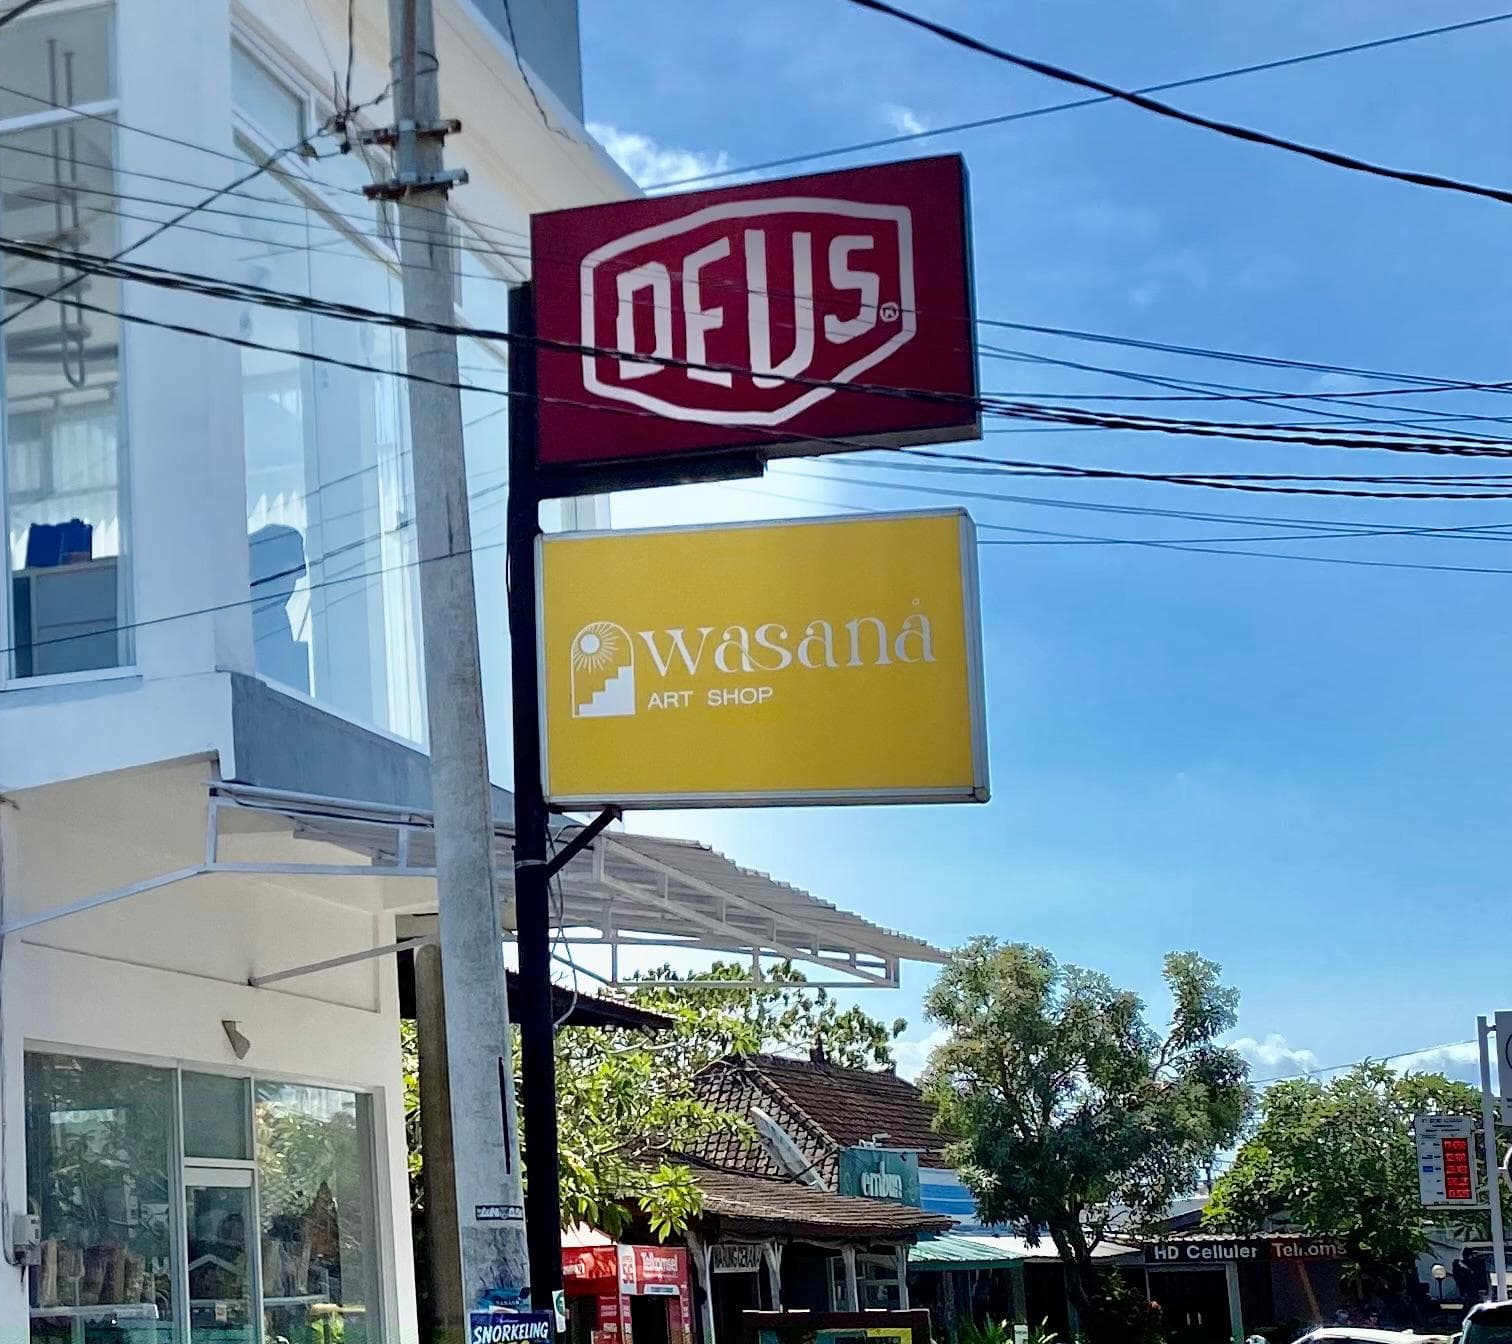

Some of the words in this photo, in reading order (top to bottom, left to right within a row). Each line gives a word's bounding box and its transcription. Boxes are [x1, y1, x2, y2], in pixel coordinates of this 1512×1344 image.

[615, 228, 882, 389] DEUS
[648, 690, 694, 710] ART
[707, 686, 773, 707] SHOP
[861, 1161, 902, 1199] embun
[1154, 1245, 1180, 1260] HD
[1186, 1244, 1257, 1260] Celluler
